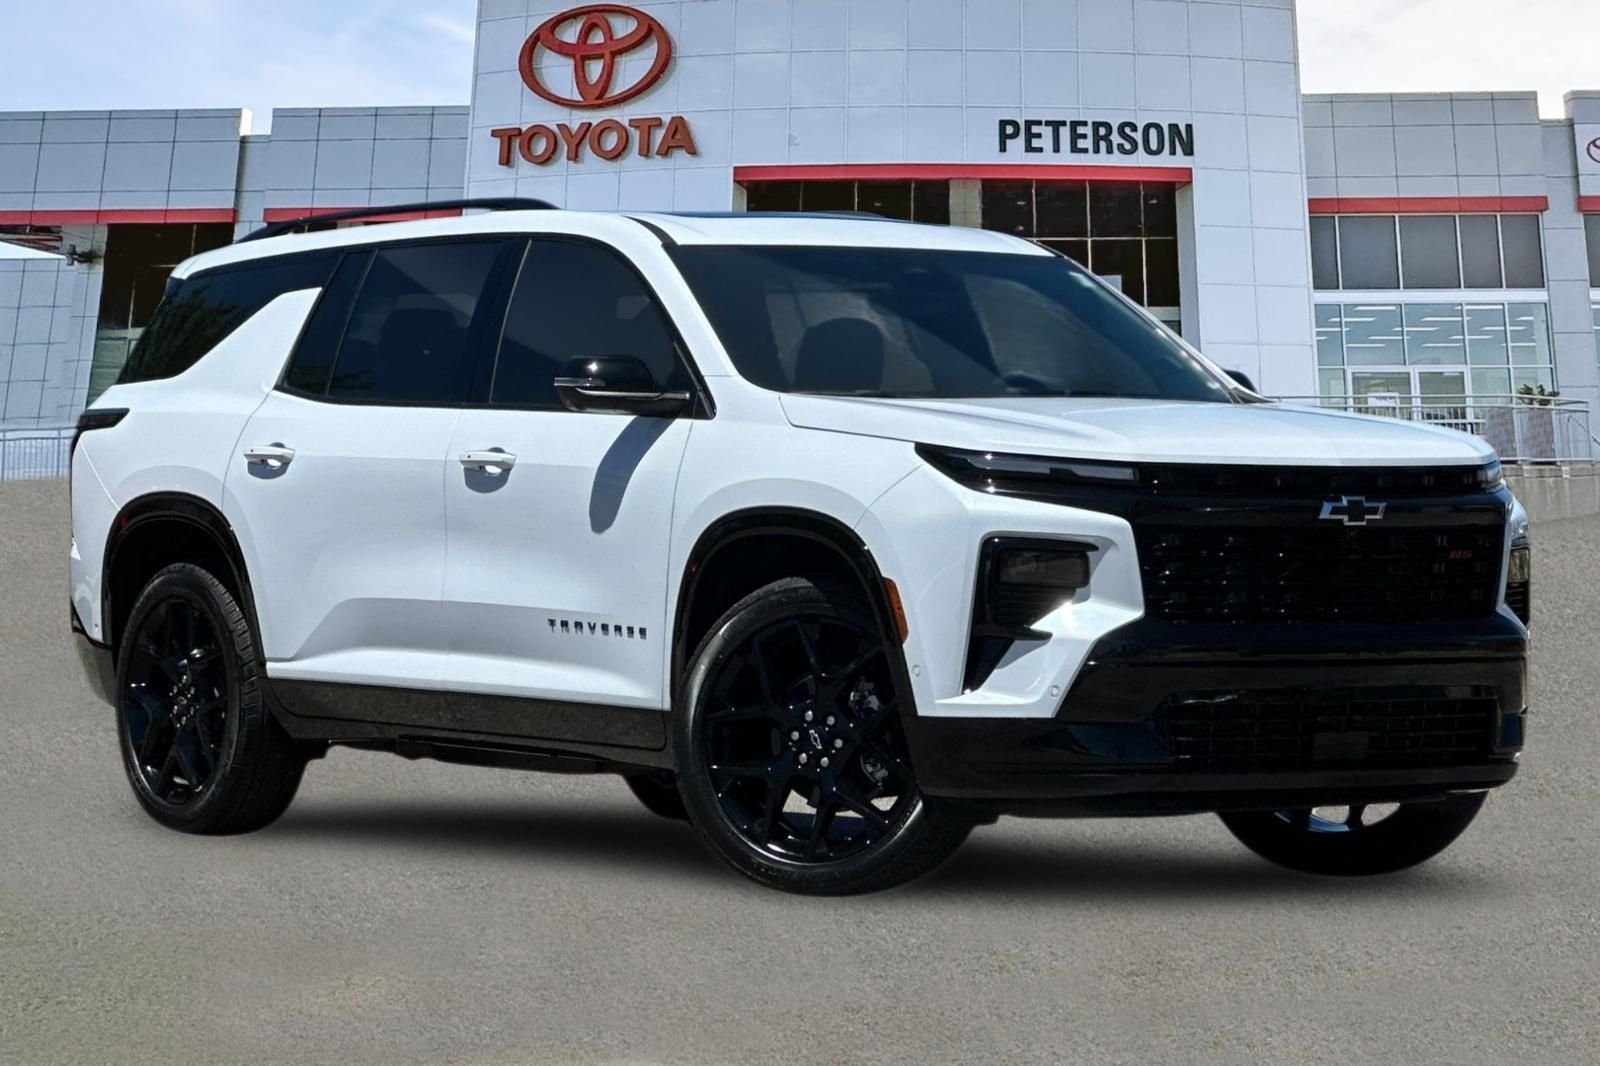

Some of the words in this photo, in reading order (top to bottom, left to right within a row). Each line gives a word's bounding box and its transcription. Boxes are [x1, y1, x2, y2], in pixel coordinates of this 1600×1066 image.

[491, 116, 697, 166] TOYOTA
[998, 119, 1194, 156] PETERSON
[547, 618, 647, 639] TRAVERSE
